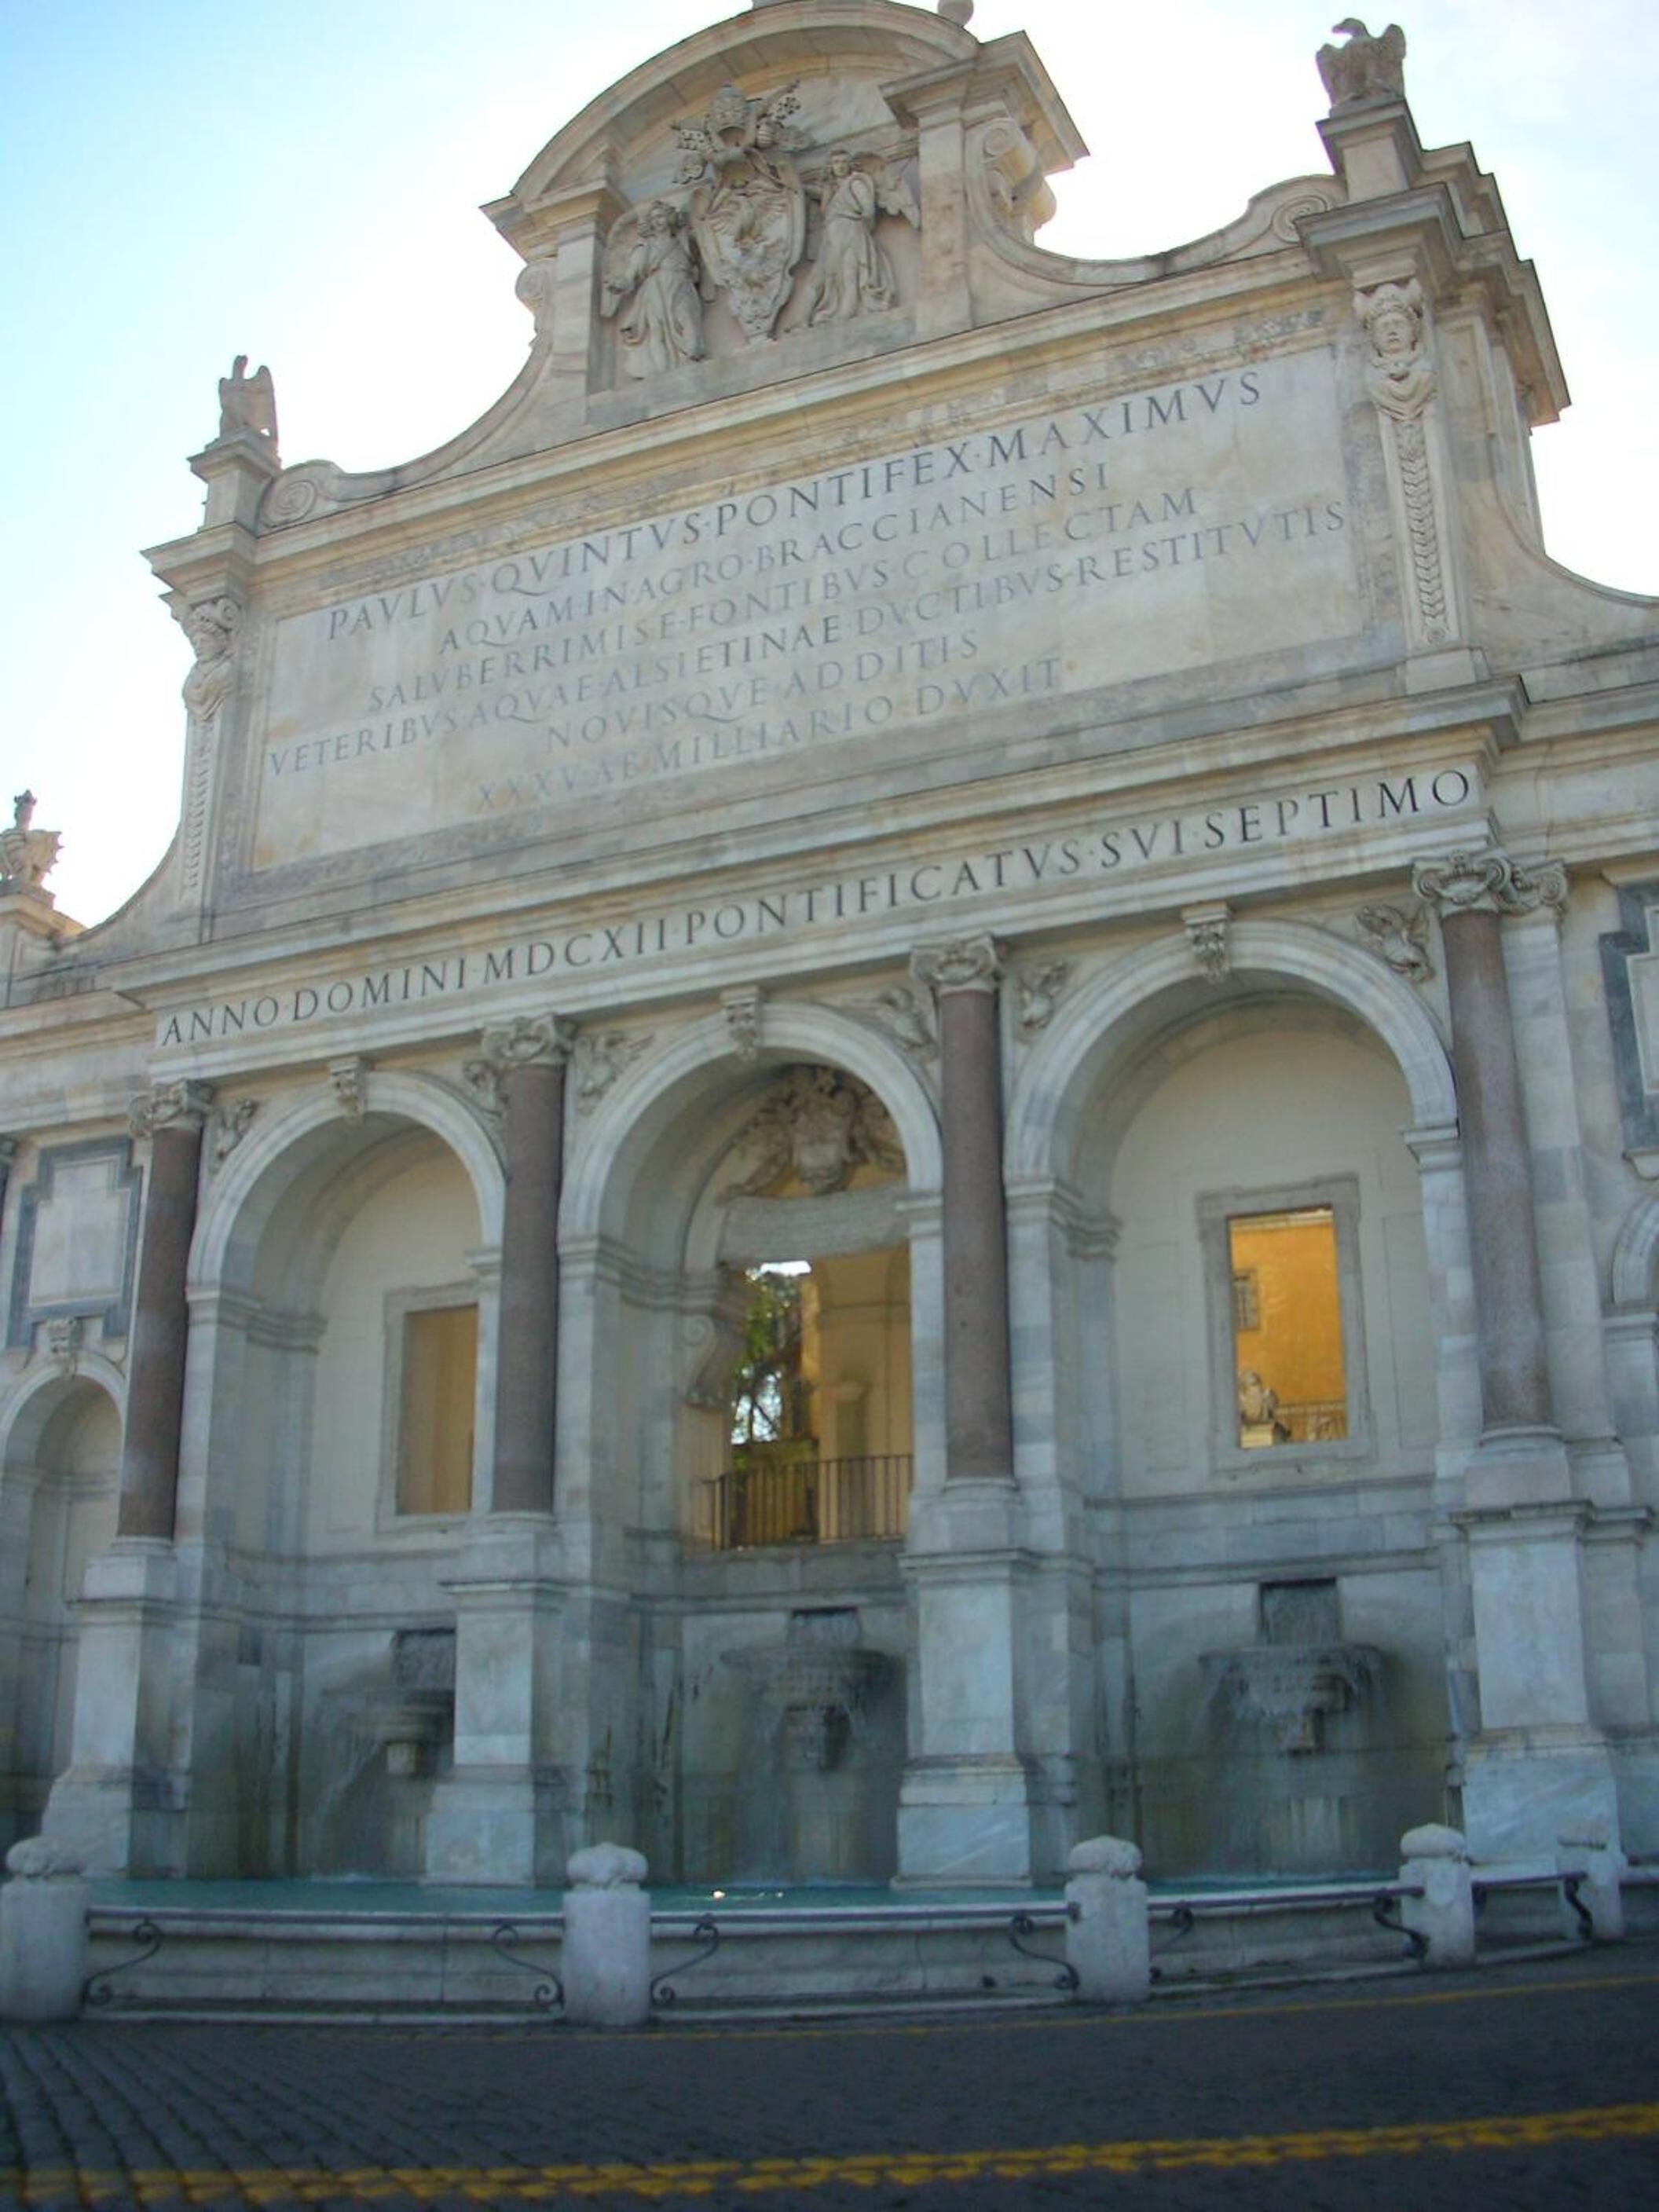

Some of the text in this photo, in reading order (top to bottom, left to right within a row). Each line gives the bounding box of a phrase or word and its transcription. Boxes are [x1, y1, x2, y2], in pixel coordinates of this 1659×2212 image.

[328, 372, 1259, 640] PAVLVS QVINTVS PONTIFEX MAXIMVS
[368, 619, 649, 712] SALVBERRIMIS
[688, 561, 889, 633] FONTIBVS
[903, 487, 1198, 580] COLLECTAM
[439, 462, 1109, 654] AQVAM IN AGRO BRACCIANENSI
[270, 500, 1346, 776] VETERIBVS AQVAE ALSIETINAE DVCTIBVS RESTITVTIS
[545, 630, 979, 754] NOVISQVE ADDITIS
[654, 696, 893, 773] MILLIARIO
[917, 657, 1062, 716] DVXIT
[160, 769, 1471, 1048] ANNO DOMINI MDCXII PONTIFICATVS SVI SEPTIMO
